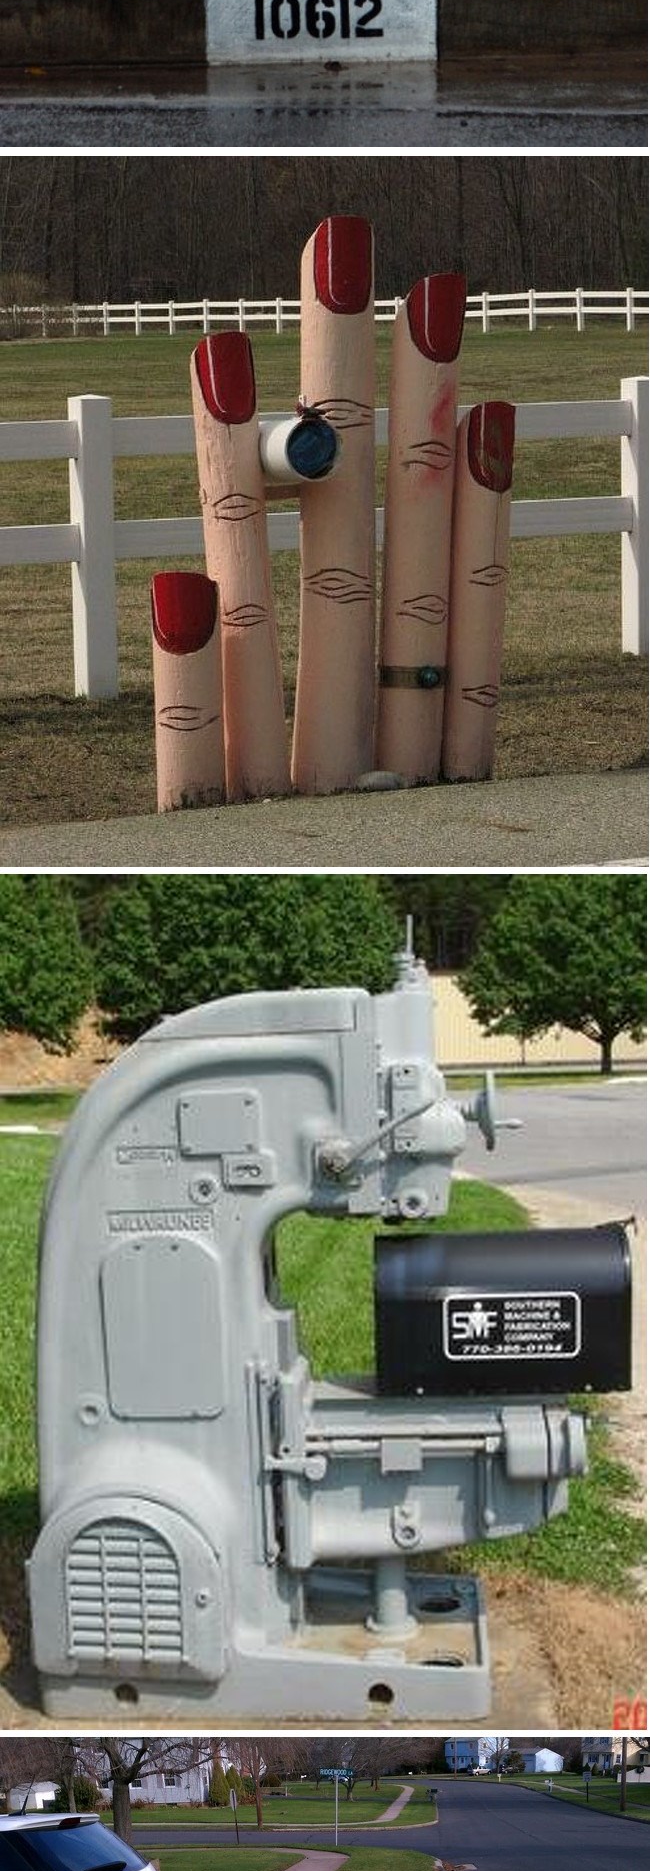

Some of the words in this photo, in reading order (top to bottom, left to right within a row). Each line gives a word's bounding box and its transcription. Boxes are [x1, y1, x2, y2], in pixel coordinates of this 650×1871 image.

[504, 1301, 560, 1310] SOUTHERN
[504, 1311, 550, 1320] MACHINE
[504, 1322, 571, 1330] FABRICATION
[504, 1332, 554, 1341] COMPANY
[320, 1768, 347, 1776] RIDGEWOOD
